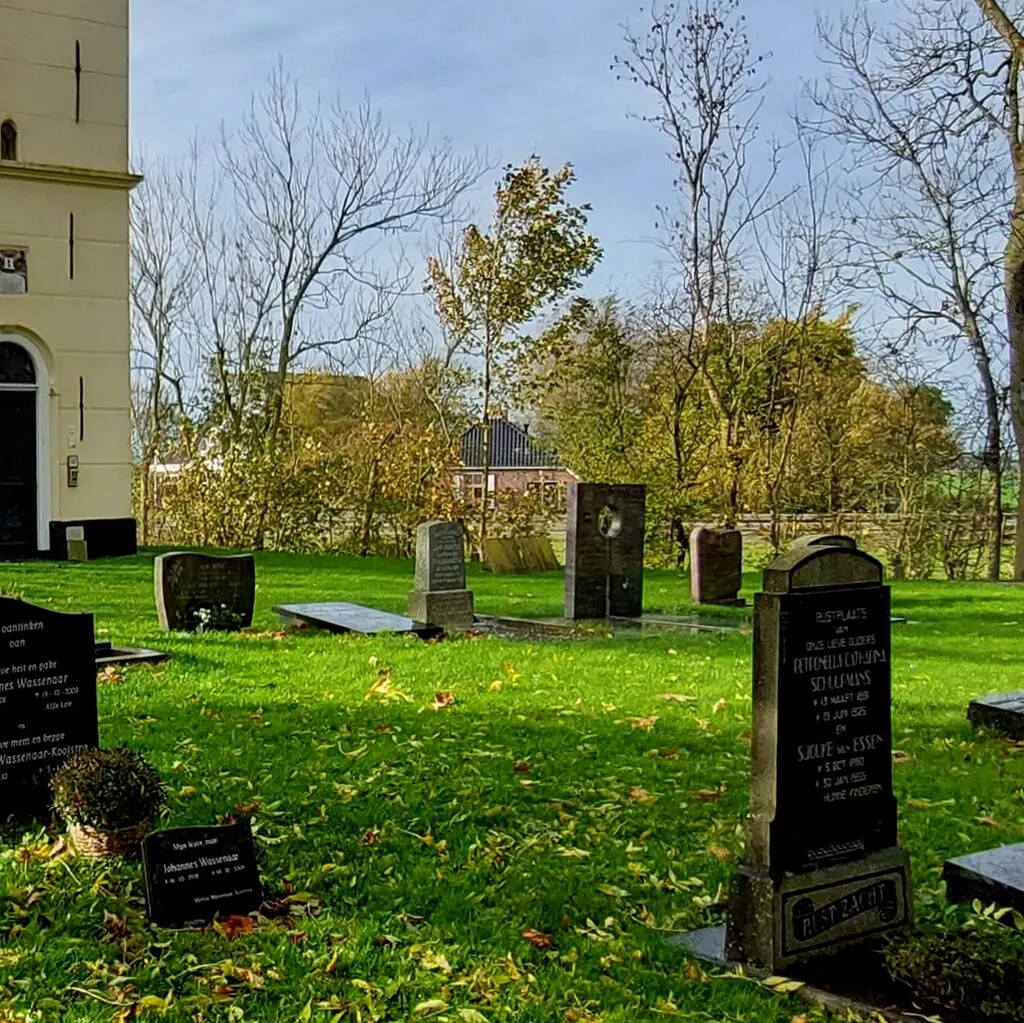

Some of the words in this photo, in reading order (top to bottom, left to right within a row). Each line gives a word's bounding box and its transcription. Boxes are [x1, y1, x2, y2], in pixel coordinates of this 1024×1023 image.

[2, 620, 44, 633] oantinken
[9, 639, 25, 648] oan
[17, 675, 68, 688] Wassenaar
[803, 905, 836, 937] RUST
[840, 884, 886, 918] ZACHT
